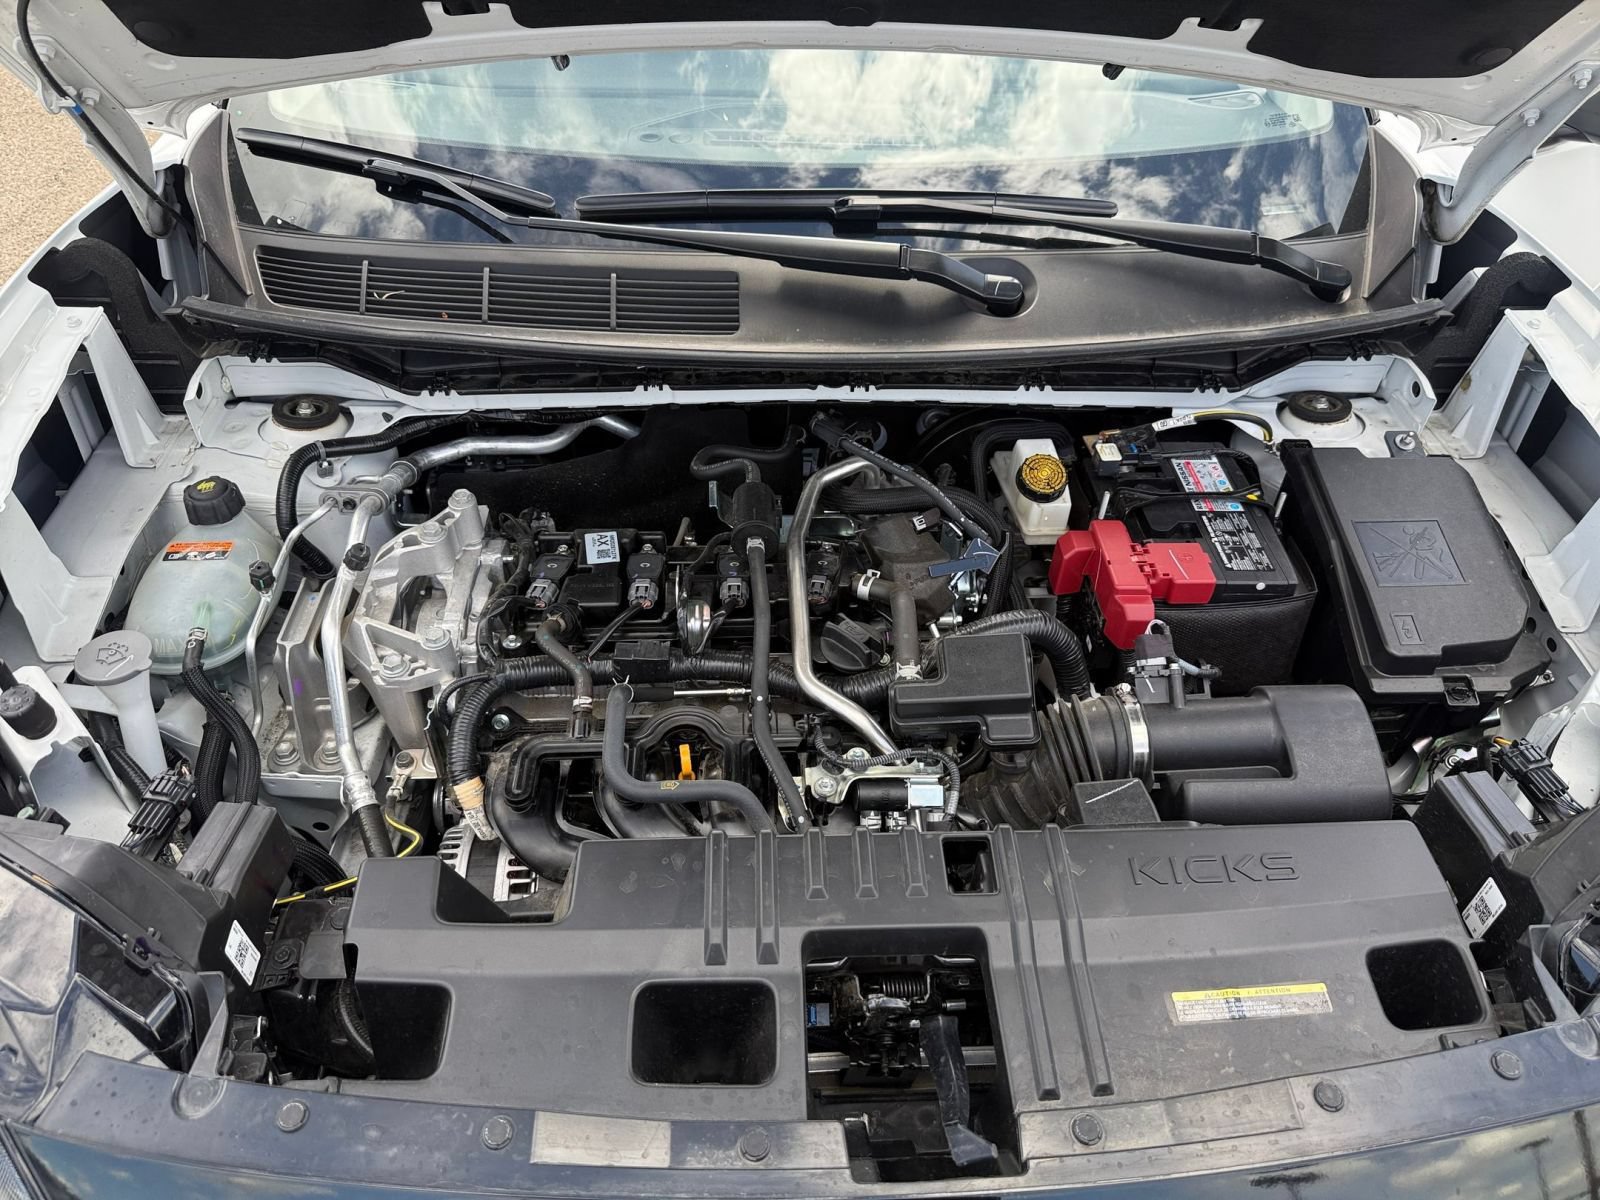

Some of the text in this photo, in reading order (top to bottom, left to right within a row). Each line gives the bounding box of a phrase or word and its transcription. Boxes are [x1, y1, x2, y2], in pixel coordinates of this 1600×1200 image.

[1175, 462, 1192, 486] NISSAN
[597, 534, 609, 547] AX
[1128, 853, 1300, 885] KICKS
[1210, 990, 1241, 998] CAUTION
[1255, 987, 1291, 995] ATTENTION
